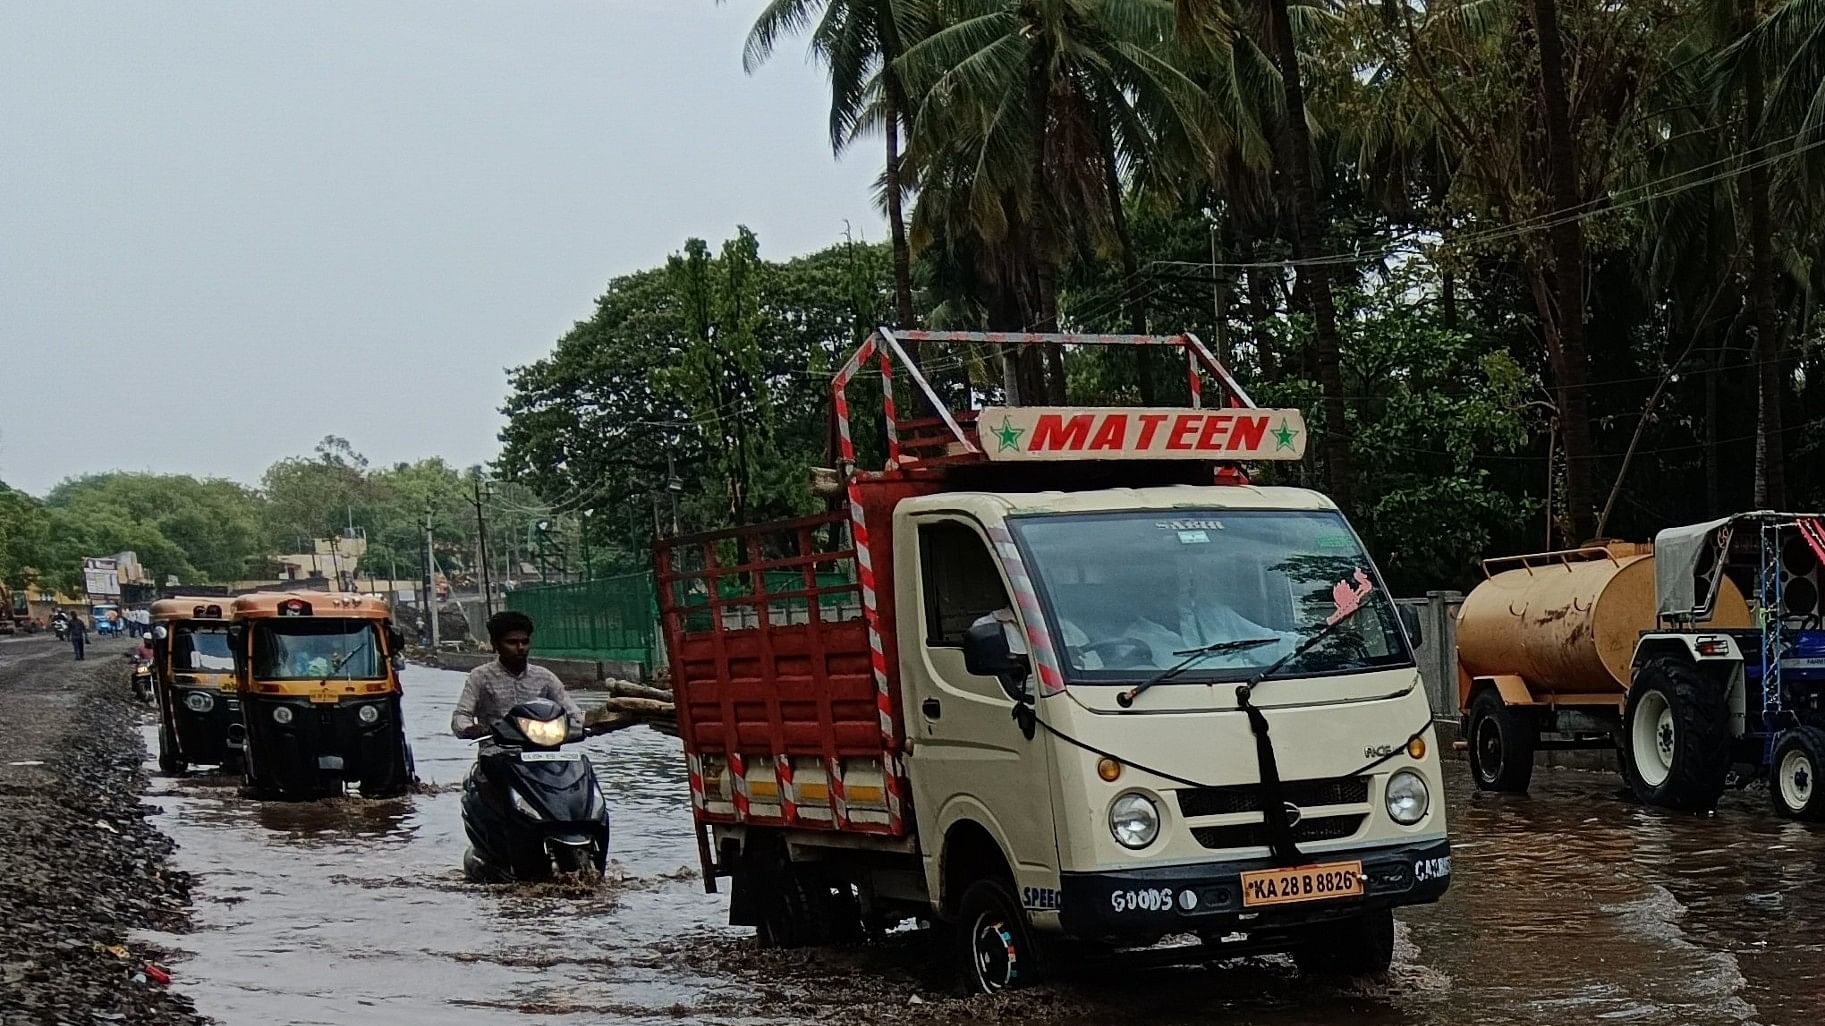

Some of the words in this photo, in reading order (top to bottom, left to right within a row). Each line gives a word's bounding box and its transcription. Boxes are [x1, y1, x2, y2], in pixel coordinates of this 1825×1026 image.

[1027, 414, 1270, 451] MATEEN
[1254, 878, 1277, 899] KA
[1280, 876, 1299, 896] 28
[1303, 875, 1313, 895] B
[1317, 870, 1351, 893] 8826
[1111, 888, 1173, 913] GOODS
